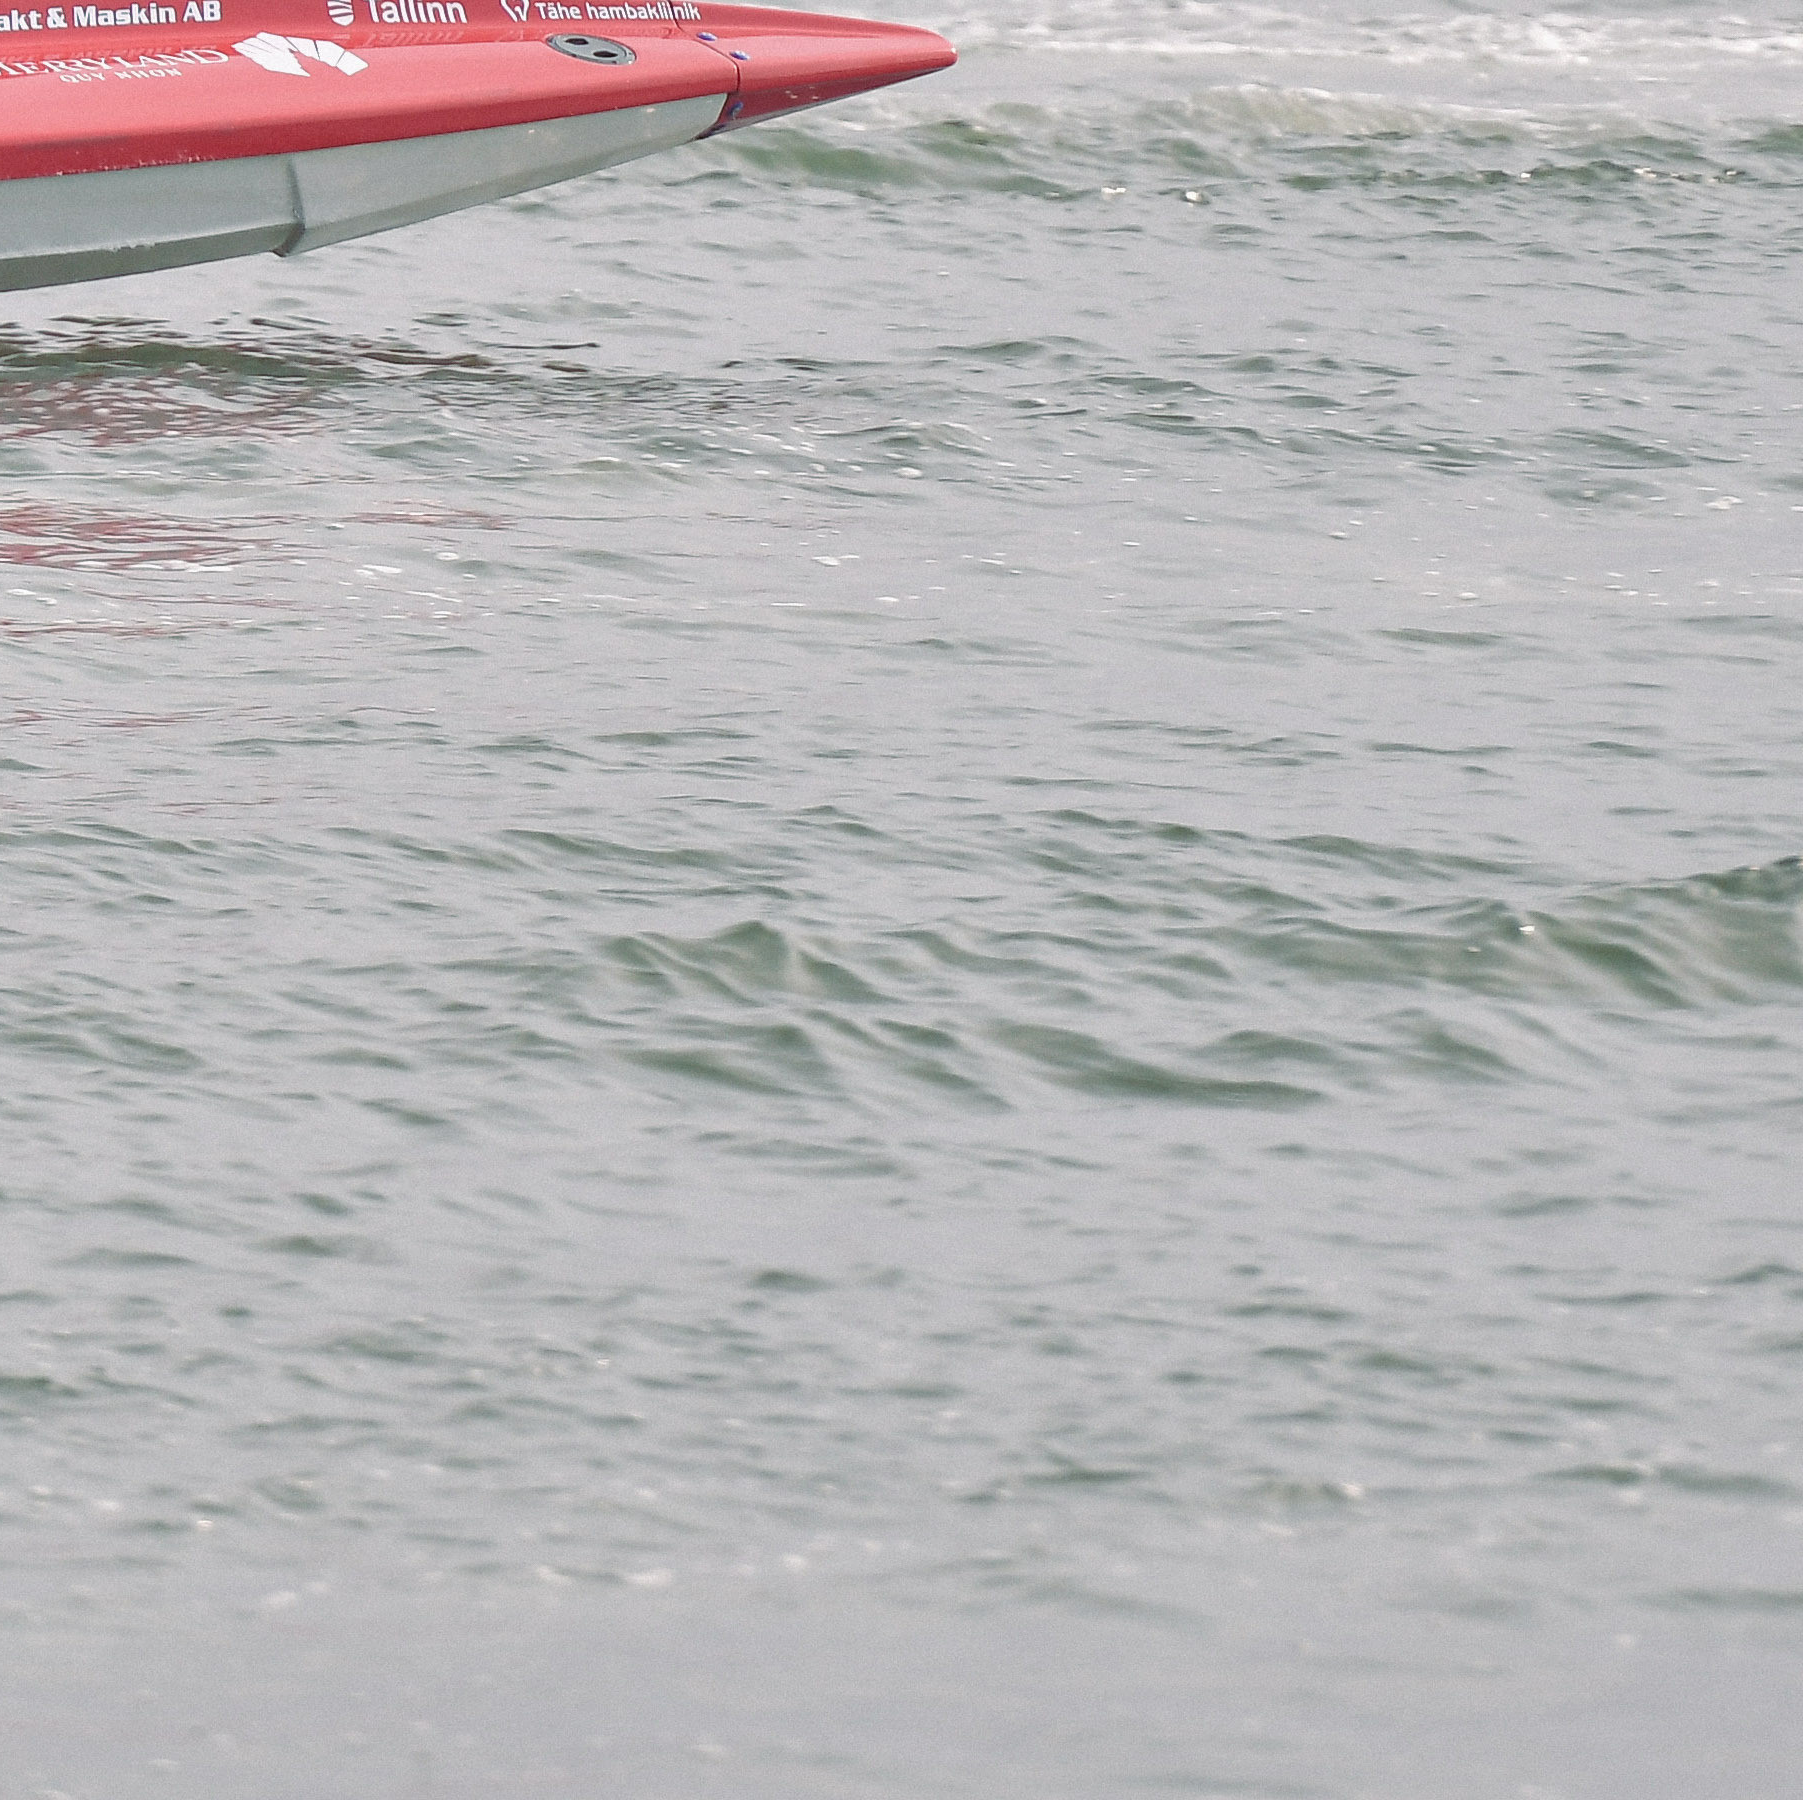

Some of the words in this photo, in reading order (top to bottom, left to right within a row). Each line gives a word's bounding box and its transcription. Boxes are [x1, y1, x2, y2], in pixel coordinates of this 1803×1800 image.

[46, 6, 68, 29] &
[73, 3, 176, 27] Maskin
[183, 0, 222, 22] AB
[534, 1, 583, 20] Tähe
